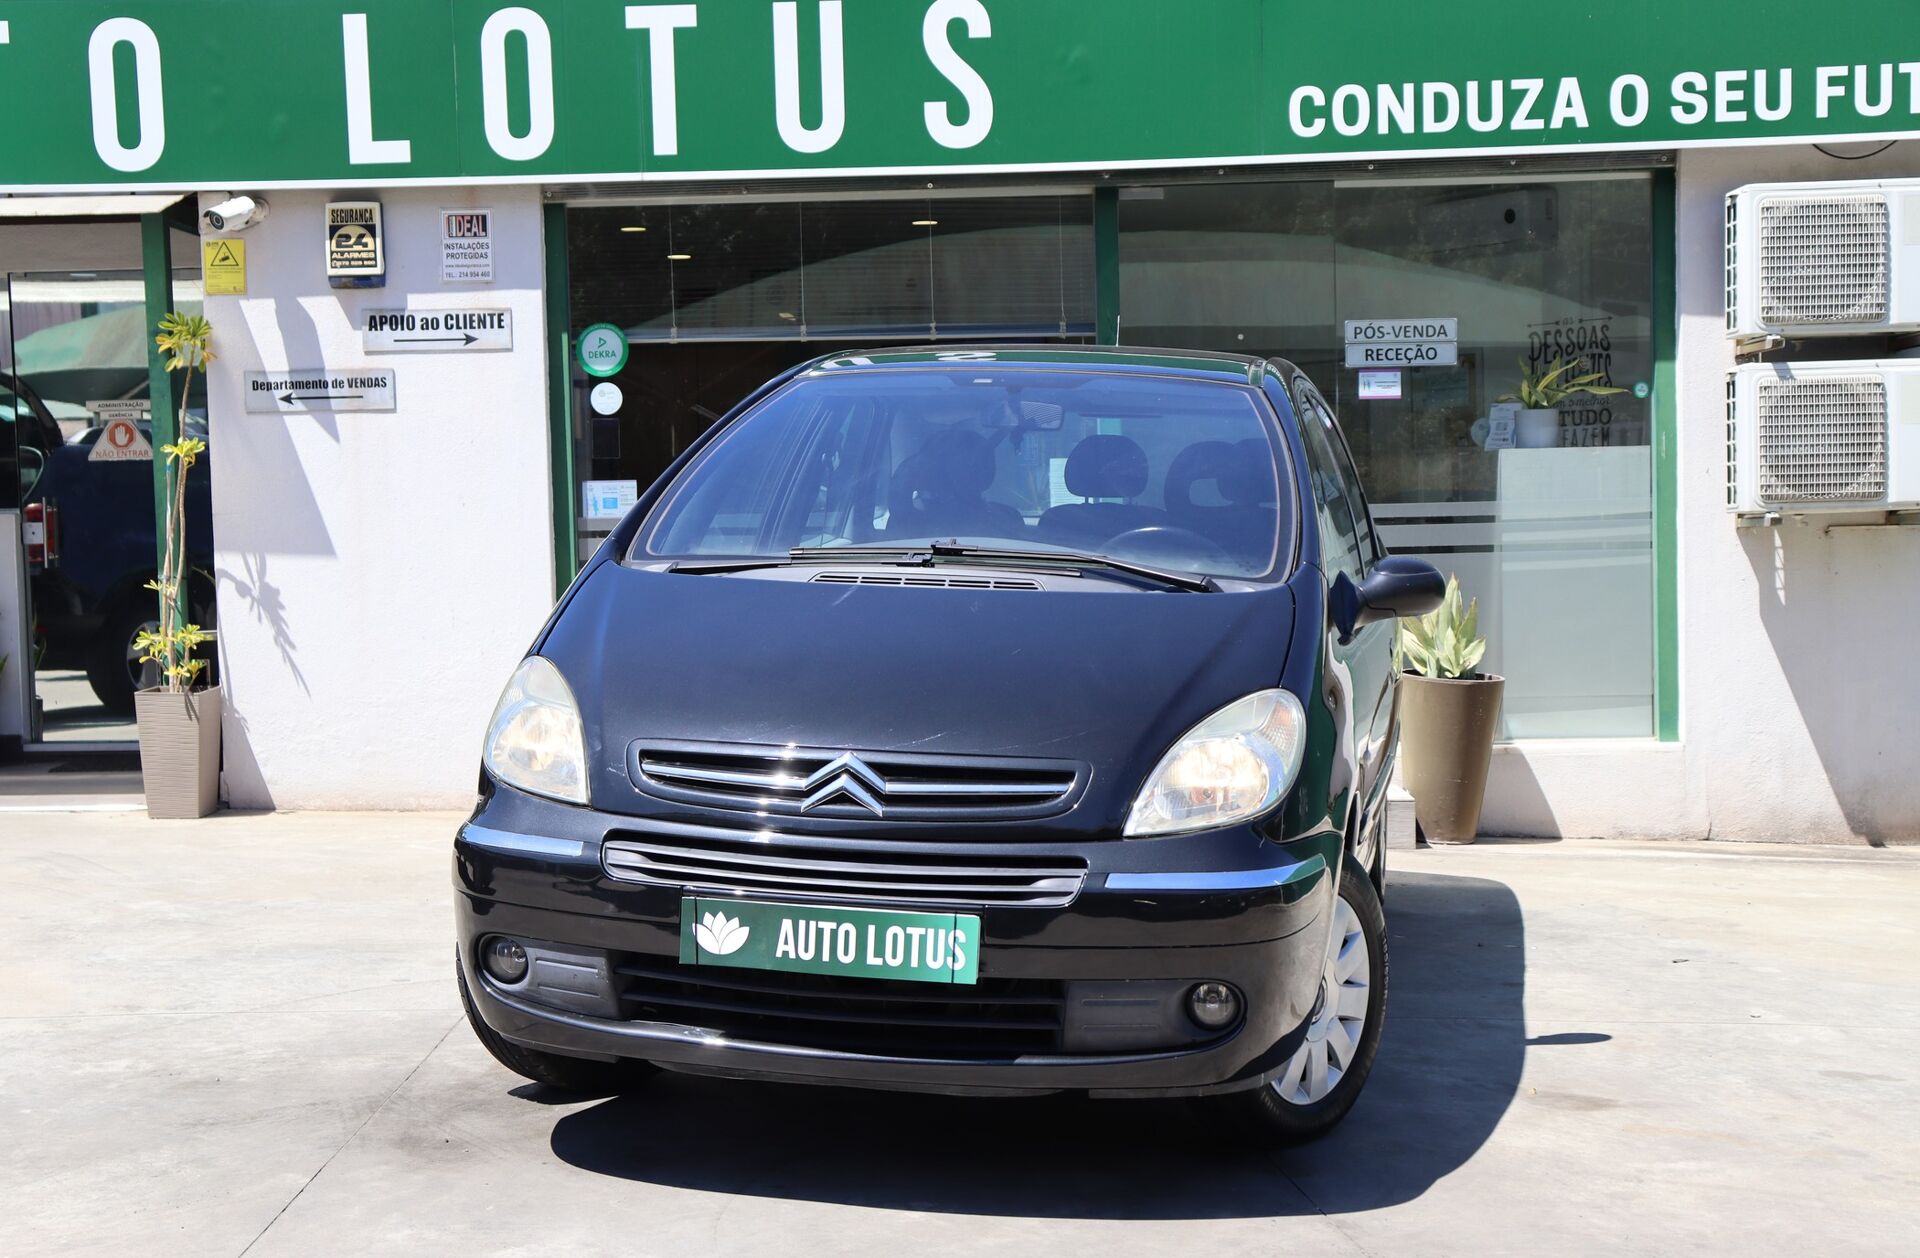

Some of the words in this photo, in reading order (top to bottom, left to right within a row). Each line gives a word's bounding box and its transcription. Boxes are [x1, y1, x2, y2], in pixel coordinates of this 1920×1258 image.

[342, 0, 994, 164] LOTUS
[1288, 76, 1589, 138] CONDUZA
[1609, 74, 1649, 126] O
[1670, 68, 1793, 125] SEU
[331, 208, 374, 224] SEGURANÇA
[444, 213, 487, 237] IDEAL
[331, 251, 375, 259] ALARMES
[444, 241, 490, 251] INSTALAÇÕES
[446, 251, 489, 260] PROTEGIDAS
[368, 314, 416, 332] APOIO
[420, 315, 440, 331] ao
[444, 312, 505, 330] CLIENTE
[1353, 323, 1449, 340] PÓS-VENDA
[588, 350, 617, 359] DEKRA
[1364, 344, 1438, 364] RECEÇÃO
[1529, 325, 1611, 374] PESSOAS
[252, 378, 329, 391] Departamento
[331, 377, 345, 389] de
[346, 376, 388, 389] VENDAS
[1559, 407, 1613, 427] TUDO
[95, 449, 114, 459] NÃO
[116, 449, 149, 458] ENTRAR
[775, 918, 857, 965] AUTO
[866, 924, 967, 971] LOTUS
